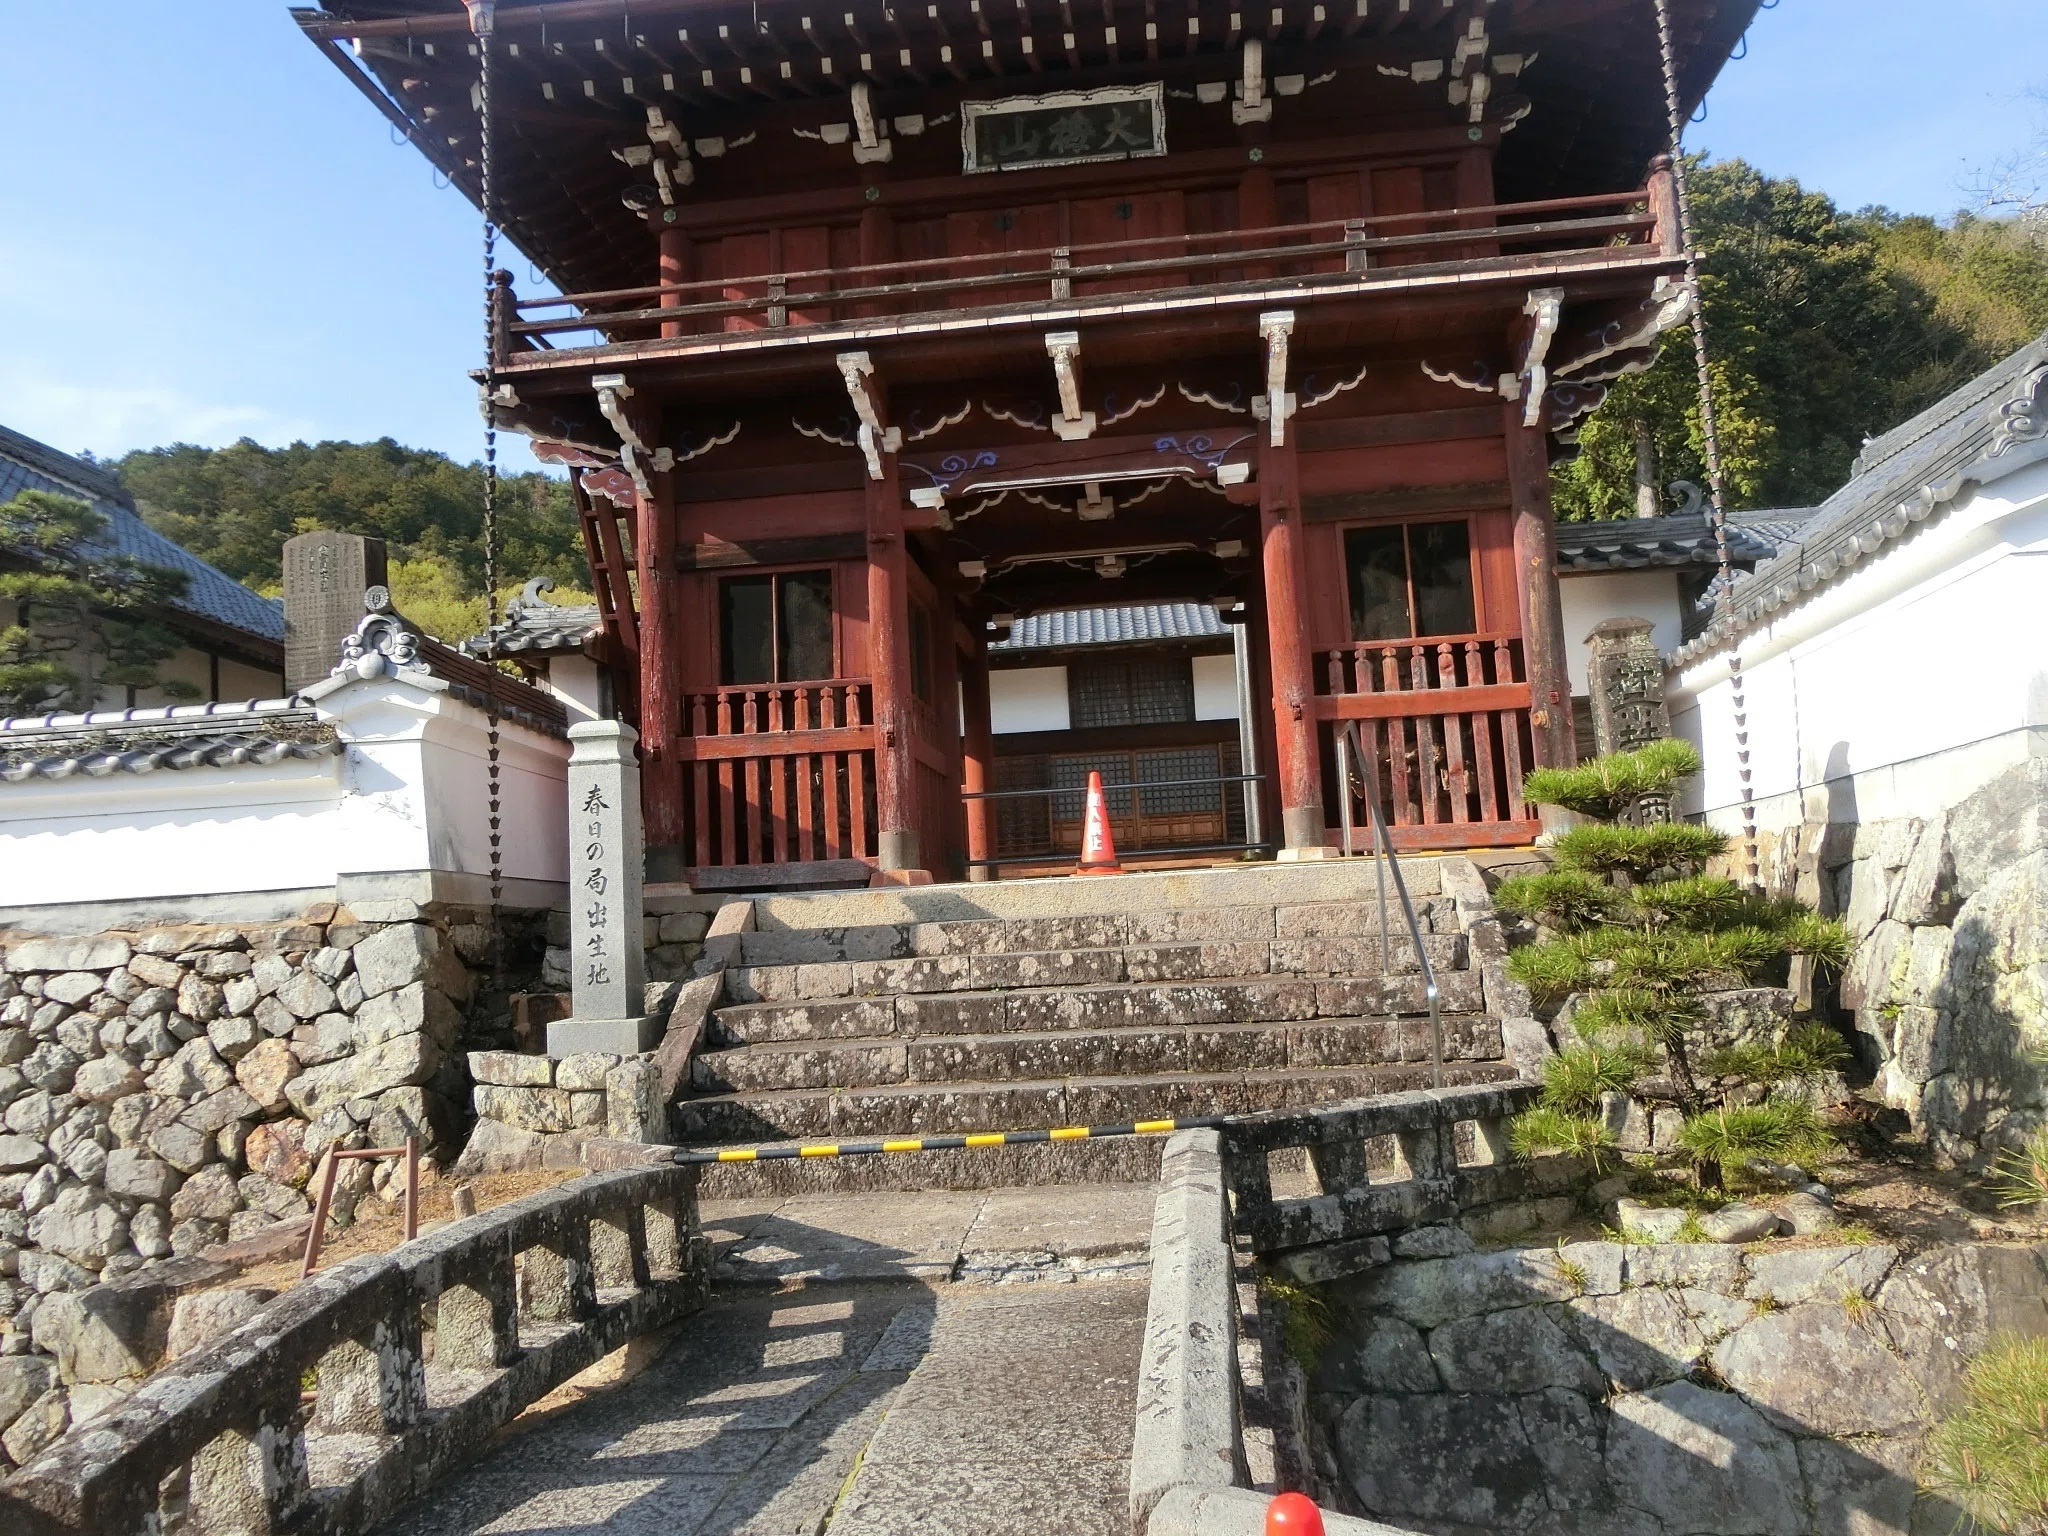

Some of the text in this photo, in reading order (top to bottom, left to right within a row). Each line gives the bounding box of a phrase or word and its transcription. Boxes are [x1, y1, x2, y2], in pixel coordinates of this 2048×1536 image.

[582, 783, 611, 986] 春日の局出生地
